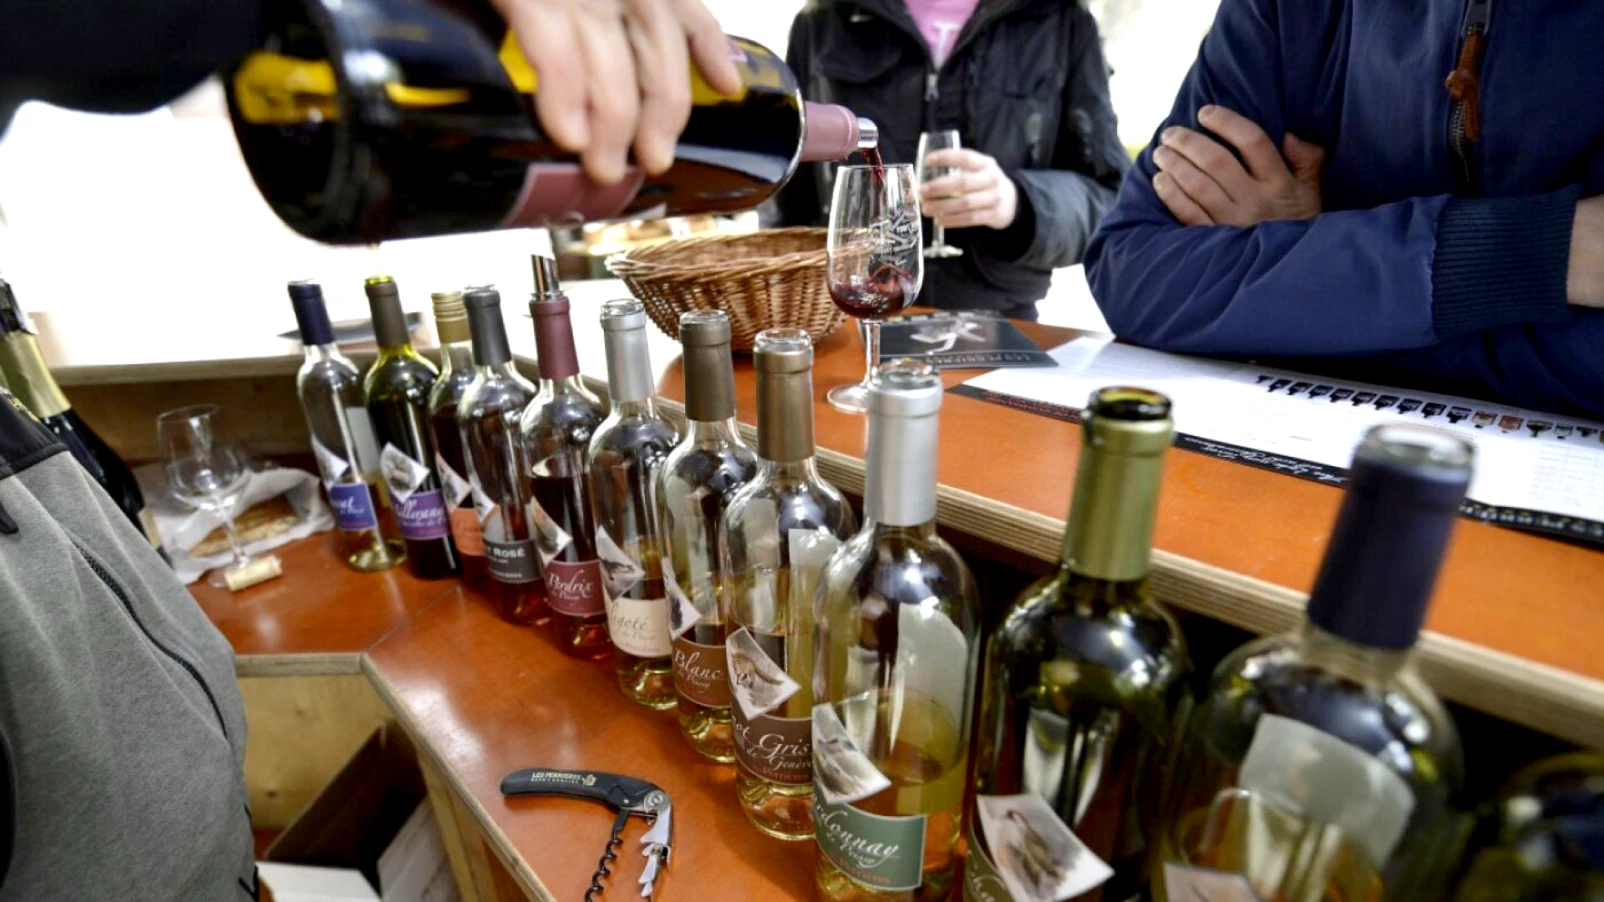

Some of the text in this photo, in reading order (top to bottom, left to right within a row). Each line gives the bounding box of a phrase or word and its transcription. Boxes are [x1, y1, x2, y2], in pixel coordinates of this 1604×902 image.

[493, 546, 526, 559] ROSÉ
[549, 569, 594, 599] Perdrix
[674, 648, 723, 681] Blanc
[759, 733, 809, 760] Gris
